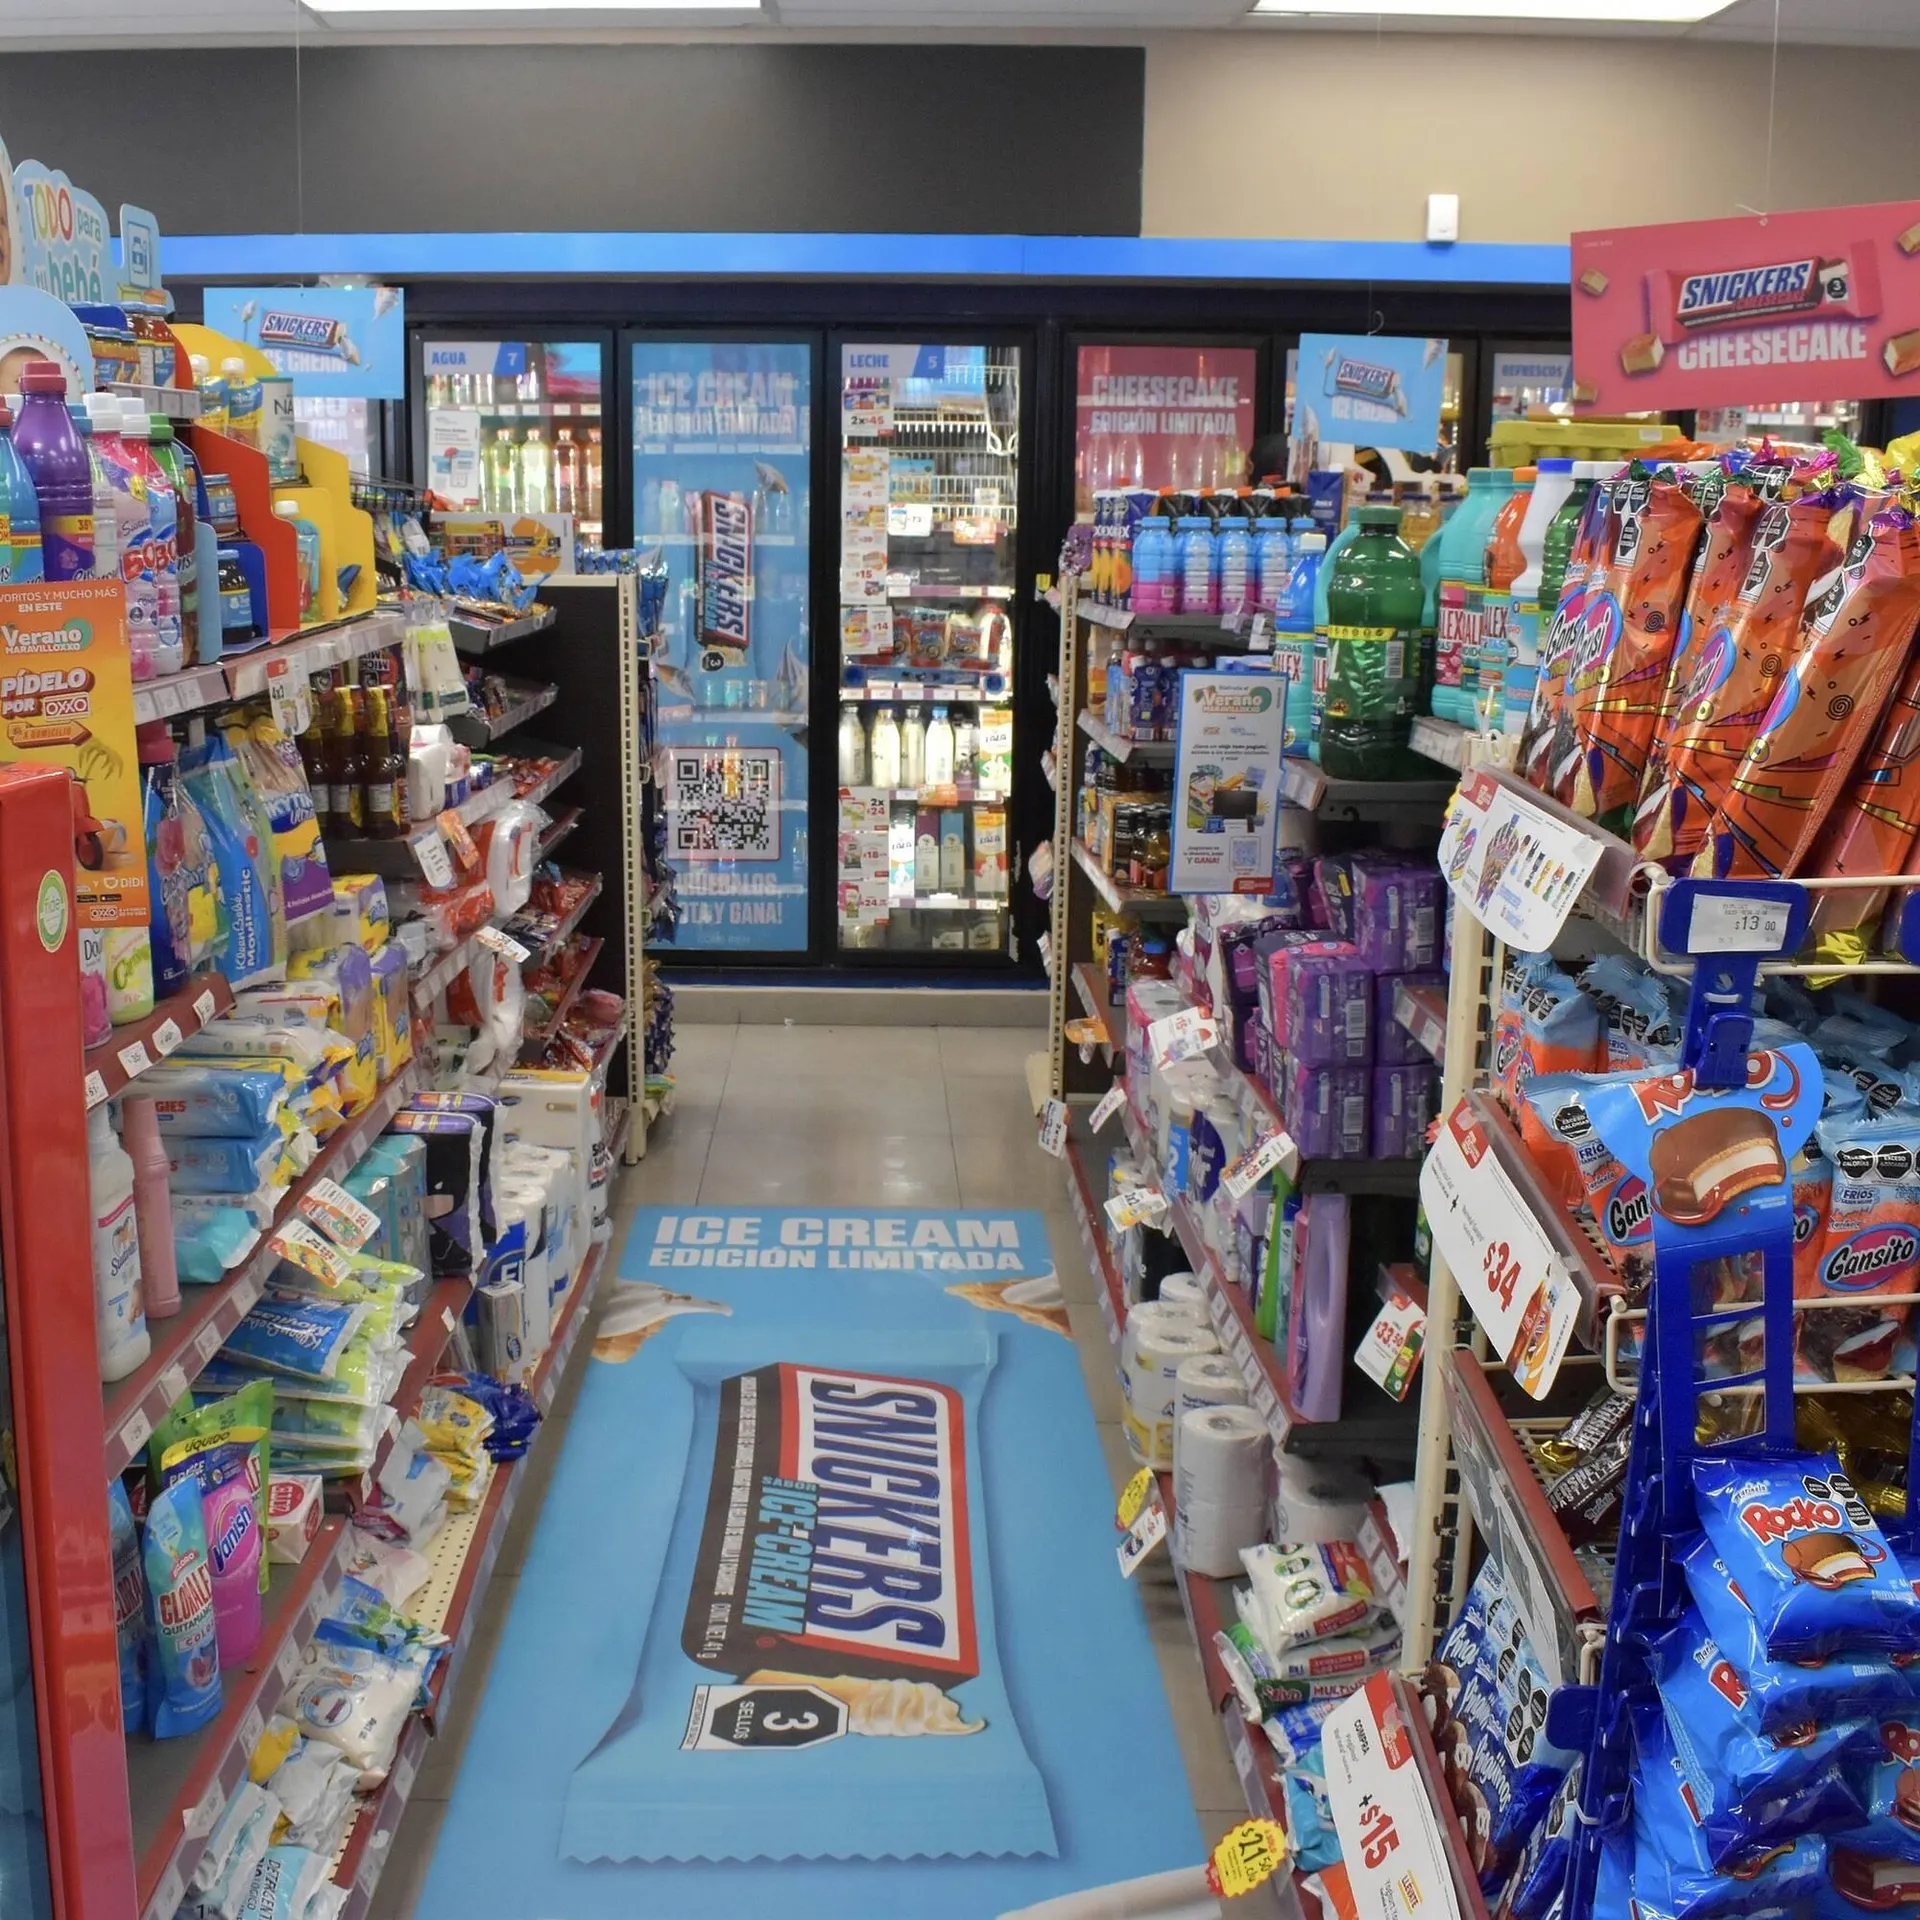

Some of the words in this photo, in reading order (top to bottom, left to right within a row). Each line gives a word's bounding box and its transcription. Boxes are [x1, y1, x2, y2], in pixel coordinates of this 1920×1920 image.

[24, 184, 73, 242] TODO
[76, 206, 103, 241] para
[1683, 262, 1810, 310] SNICKERS
[1832, 278, 1842, 291] 3
[265, 315, 330, 337] SNICKERS
[431, 350, 468, 366] AGUA
[507, 351, 518, 366] 7
[1677, 323, 1868, 370] CHEESECAKE
[850, 354, 890, 368] LECHE
[928, 356, 938, 369] 5
[1339, 362, 1390, 388] SNICKERS
[648, 373, 693, 408] ICE
[700, 372, 795, 409] CREAM
[1092, 375, 1239, 409] CHEESECAKE
[1091, 409, 1158, 435] EDICIÓN
[1160, 411, 1237, 435] LIMITADA
[712, 498, 750, 640] SNICKERS
[43, 590, 51, 601] Y
[52, 588, 93, 600] MUCHO
[95, 586, 118, 599] MÁS
[18, 603, 33, 613] EN
[35, 601, 63, 612] ESTE
[1, 625, 83, 647] Verano
[5, 643, 82, 655] MARAVILLOXXO
[2, 668, 87, 698] PÍDELO
[2, 698, 36, 716] POR
[45, 698, 88, 717] OXXO
[1202, 687, 1264, 707] Verano
[1194, 857, 1220, 865] GANA!
[90, 907, 118, 918] OXXO
[729, 902, 784, 925] GANA!
[1734, 915, 1760, 931] $13
[1764, 919, 1776, 931] 00
[154, 1100, 187, 1113] GIES
[1579, 1142, 1605, 1161] FRÍO
[654, 1215, 762, 1247] ICE
[779, 1218, 1020, 1248] CREAM
[648, 1246, 817, 1269] EDICIÓN
[827, 1249, 1025, 1272] LIMITADA
[1825, 1235, 1915, 1284] Gansito
[1483, 1240, 1523, 1314] $34
[761, 1475, 818, 1492] SABOR
[809, 1377, 947, 1649] SNICKERS
[1740, 1496, 1842, 1547] Rocko
[211, 1503, 254, 1574] Vanish
[732, 1699, 755, 1740] SELLOS
[762, 1710, 820, 1731] 3
[1353, 1718, 1371, 1756] COMPRA
[1358, 1803, 1402, 1871] $15
